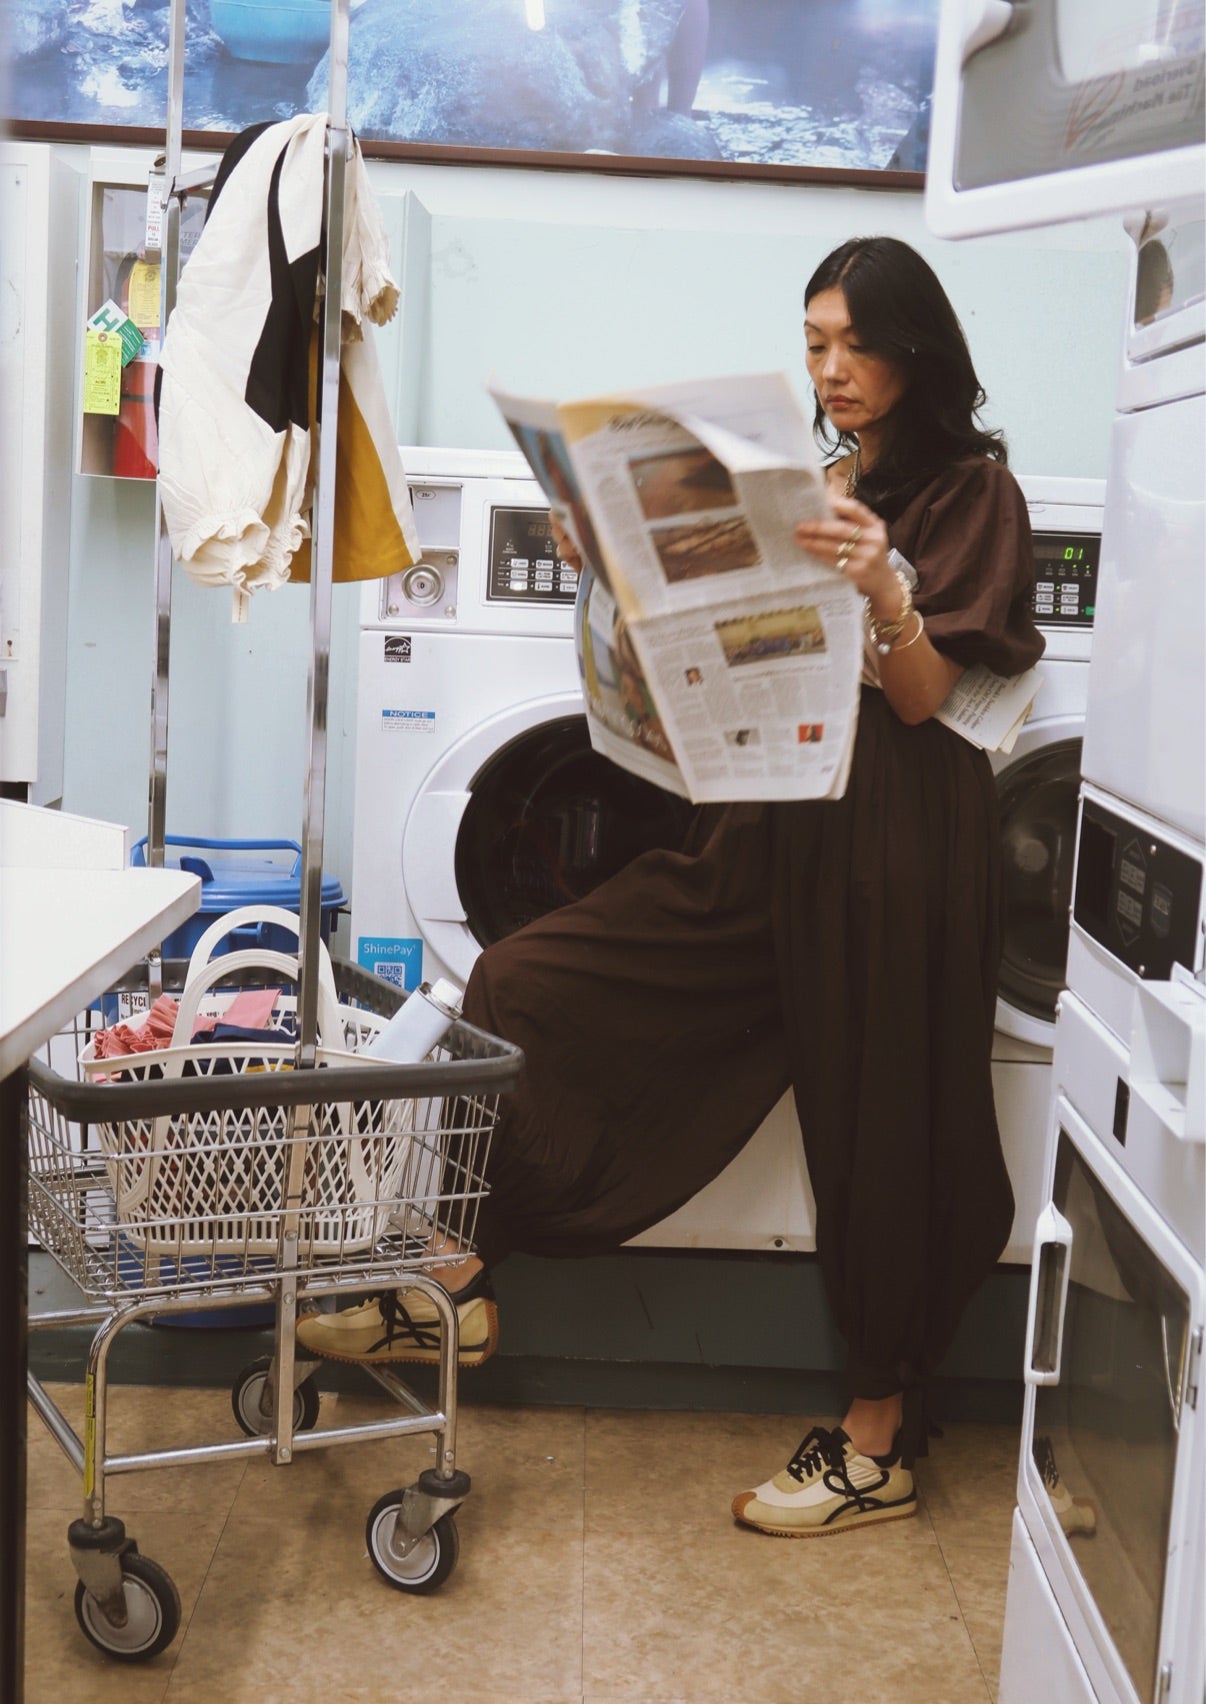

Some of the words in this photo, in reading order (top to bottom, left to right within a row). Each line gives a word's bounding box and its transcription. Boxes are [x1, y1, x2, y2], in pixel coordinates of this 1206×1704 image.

[1064, 547, 1083, 560] 01
[389, 710, 428, 719] NOTICE
[363, 943, 413, 957] ShinePay
